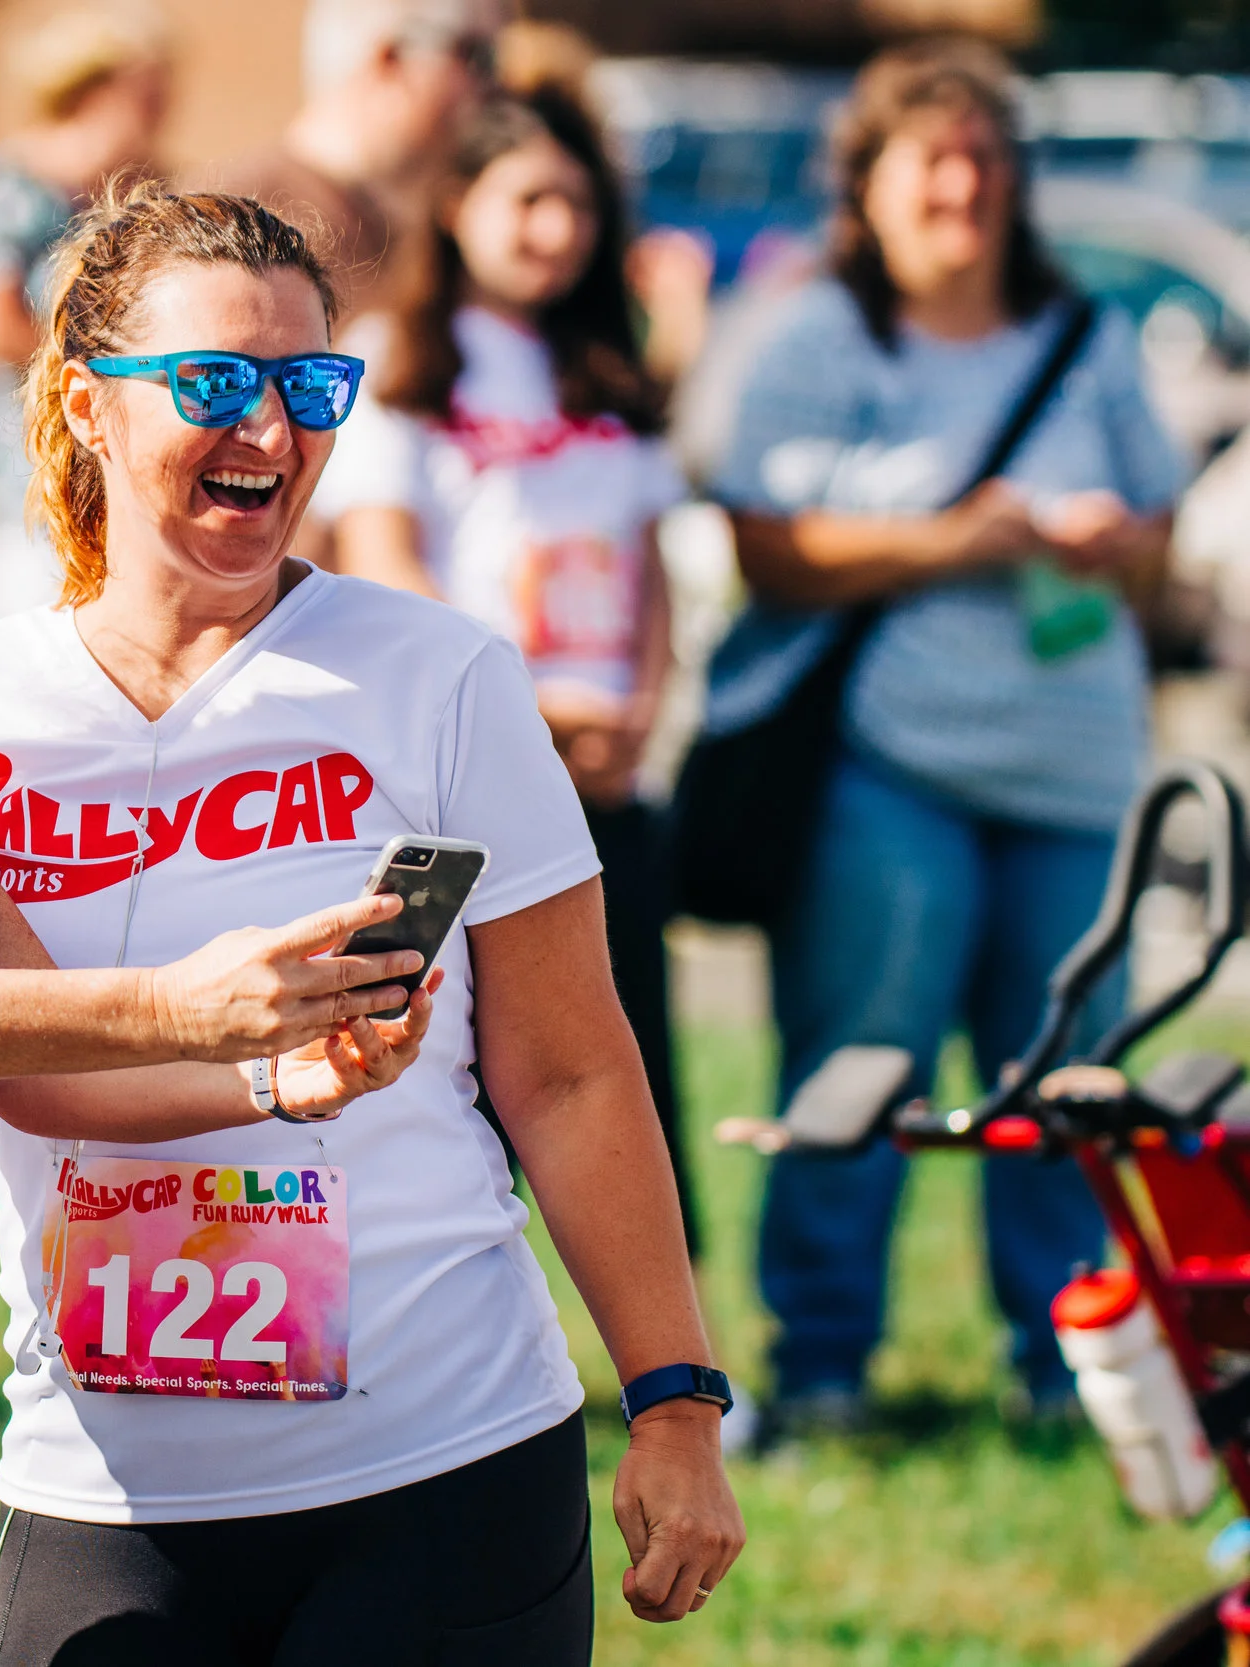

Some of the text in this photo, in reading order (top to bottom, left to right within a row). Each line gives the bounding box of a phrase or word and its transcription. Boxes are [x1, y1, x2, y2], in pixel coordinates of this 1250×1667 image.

[193, 1168, 327, 1204] COLOR
[192, 1204, 329, 1224] FUN RUN/WALK
[88, 1254, 287, 1362] 122
[90, 1372, 131, 1386] Needs.
[135, 1374, 182, 1388] Special
[187, 1376, 232, 1390] Sports.
[236, 1379, 284, 1393] Special
[288, 1380, 329, 1392] Times.
